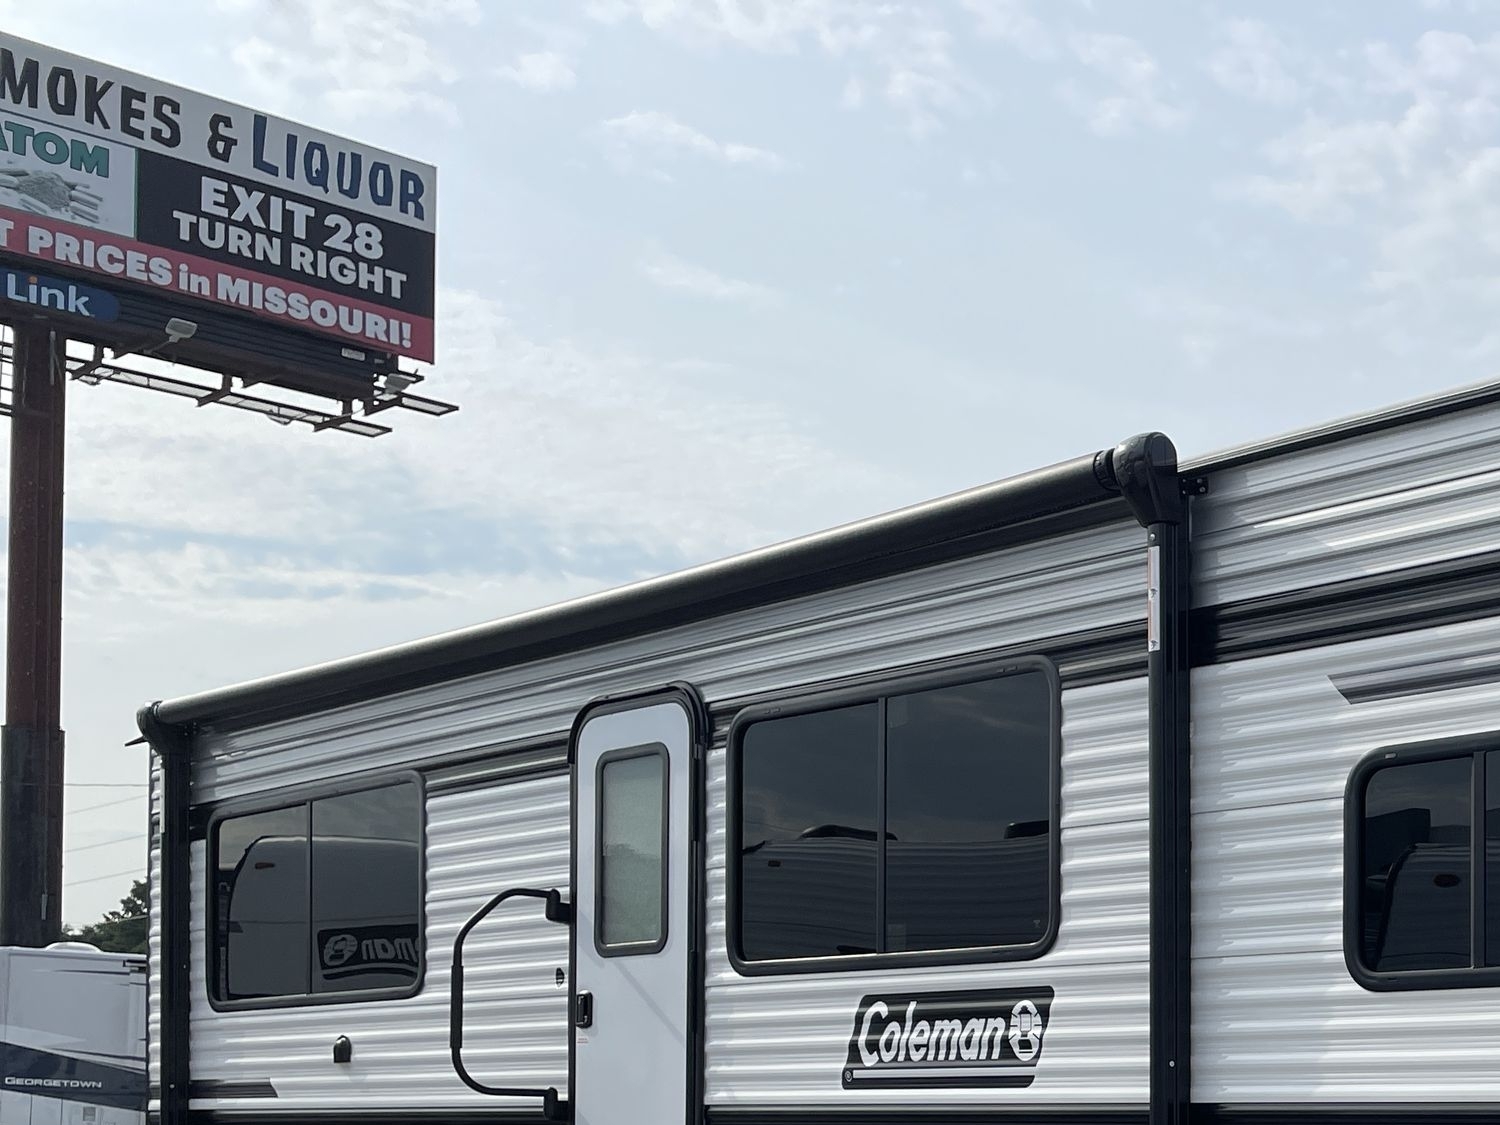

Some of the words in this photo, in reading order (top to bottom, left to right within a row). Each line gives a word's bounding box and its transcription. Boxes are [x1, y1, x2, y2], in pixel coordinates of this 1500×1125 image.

[207, 113, 238, 163] &
[253, 114, 424, 221] LIQUOR
[173, 210, 281, 266] TURN
[291, 242, 407, 299] RIGHT
[201, 175, 315, 240] EXIT
[323, 213, 383, 260] 28
[7, 272, 90, 317] Link
[28, 225, 172, 286] PRICES
[179, 263, 210, 296] in
[217, 272, 412, 348] MISSOURI!
[858, 1001, 1006, 1067] Coleman
[5, 1076, 102, 1088] GEORGETOWN
